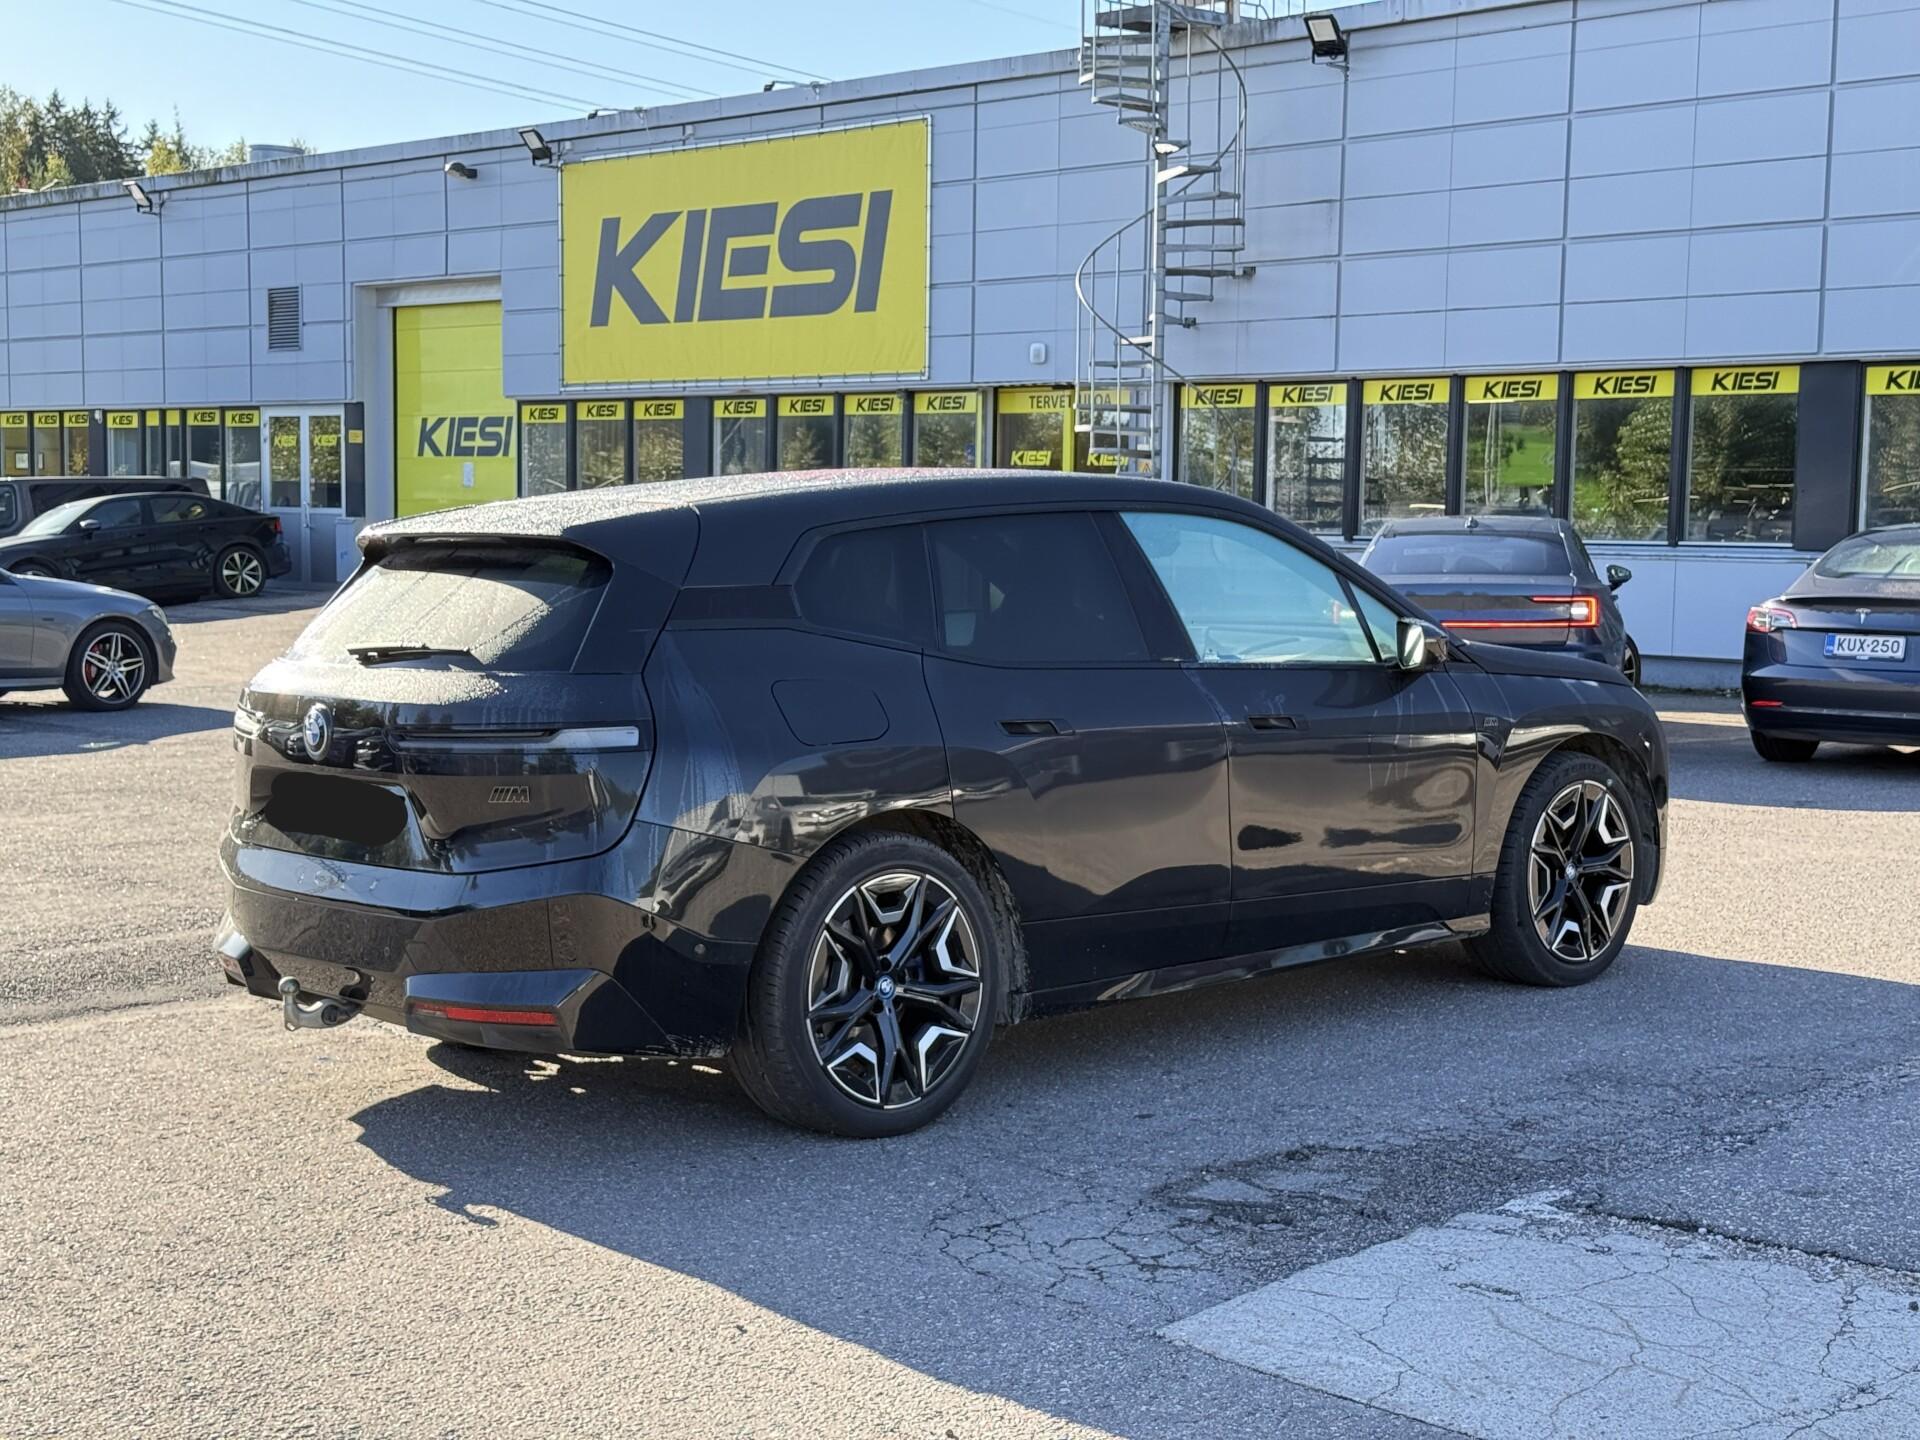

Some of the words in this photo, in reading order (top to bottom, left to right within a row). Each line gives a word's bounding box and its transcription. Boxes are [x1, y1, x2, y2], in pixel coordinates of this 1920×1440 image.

[590, 189, 893, 327] KIESI
[1594, 375, 1657, 394] KIESI
[1711, 371, 1779, 391] KIESI
[1195, 388, 1242, 405] KIESI
[1282, 386, 1333, 403] KIESI
[1380, 384, 1434, 401] KIESI
[1483, 380, 1542, 399] KIESI
[643, 402, 676, 416] KIESI
[723, 400, 757, 414] KIESI
[789, 399, 824, 413] KIESI
[856, 397, 894, 411] KIESI
[926, 396, 967, 410] KIESI
[193, 412, 215, 422] KIESI
[528, 407, 558, 420] KIESI
[586, 404, 617, 417] KIESI
[112, 415, 133, 425] KIESI
[231, 413, 254, 424] KIESI
[417, 416, 513, 457] KIESI
[1010, 451, 1051, 466] KIESI
